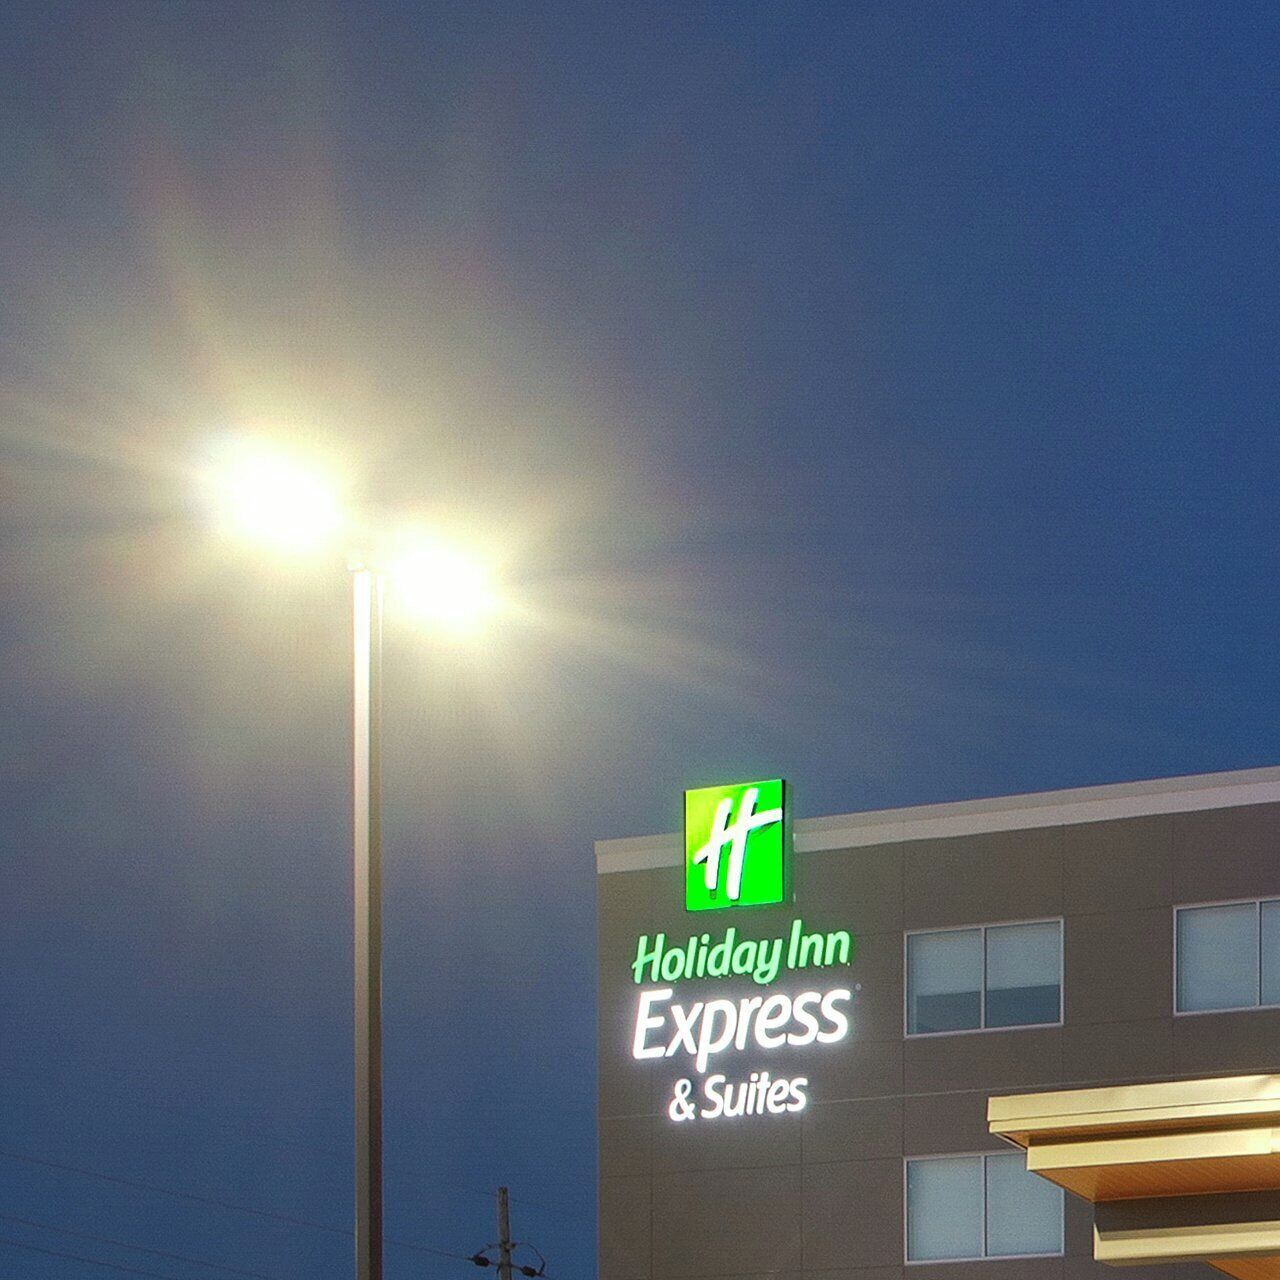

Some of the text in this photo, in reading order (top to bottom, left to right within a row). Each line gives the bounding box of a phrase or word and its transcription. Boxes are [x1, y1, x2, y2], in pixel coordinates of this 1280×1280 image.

[693, 788, 783, 901] H
[631, 919, 851, 985] Holiday Inn
[631, 988, 851, 1073] Express
[668, 1071, 808, 1122] & Suites
